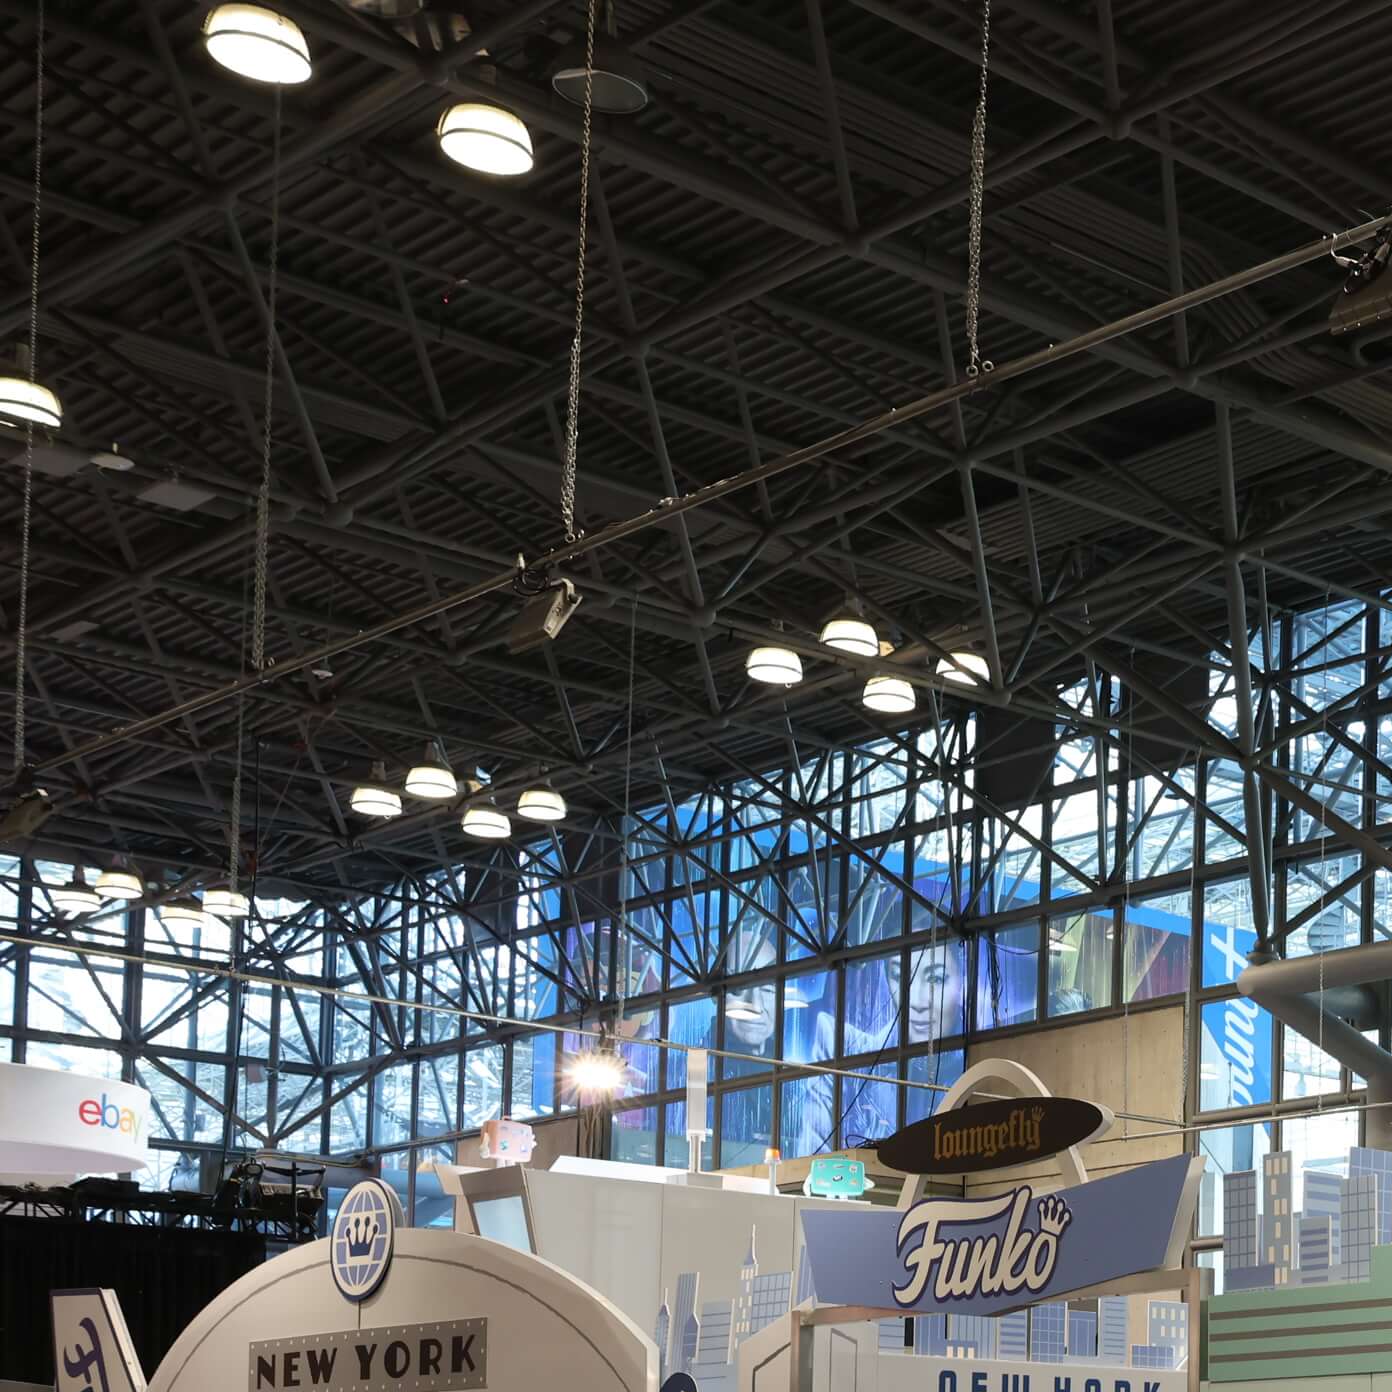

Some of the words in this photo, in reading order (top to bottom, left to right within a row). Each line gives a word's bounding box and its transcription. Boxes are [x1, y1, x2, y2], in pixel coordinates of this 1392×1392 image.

[79, 1093, 141, 1144] ebay
[934, 1108, 1042, 1160] loungefly
[893, 1186, 1062, 1304] Funko
[256, 1342, 335, 1391] NEW
[358, 1332, 477, 1384] YORK
